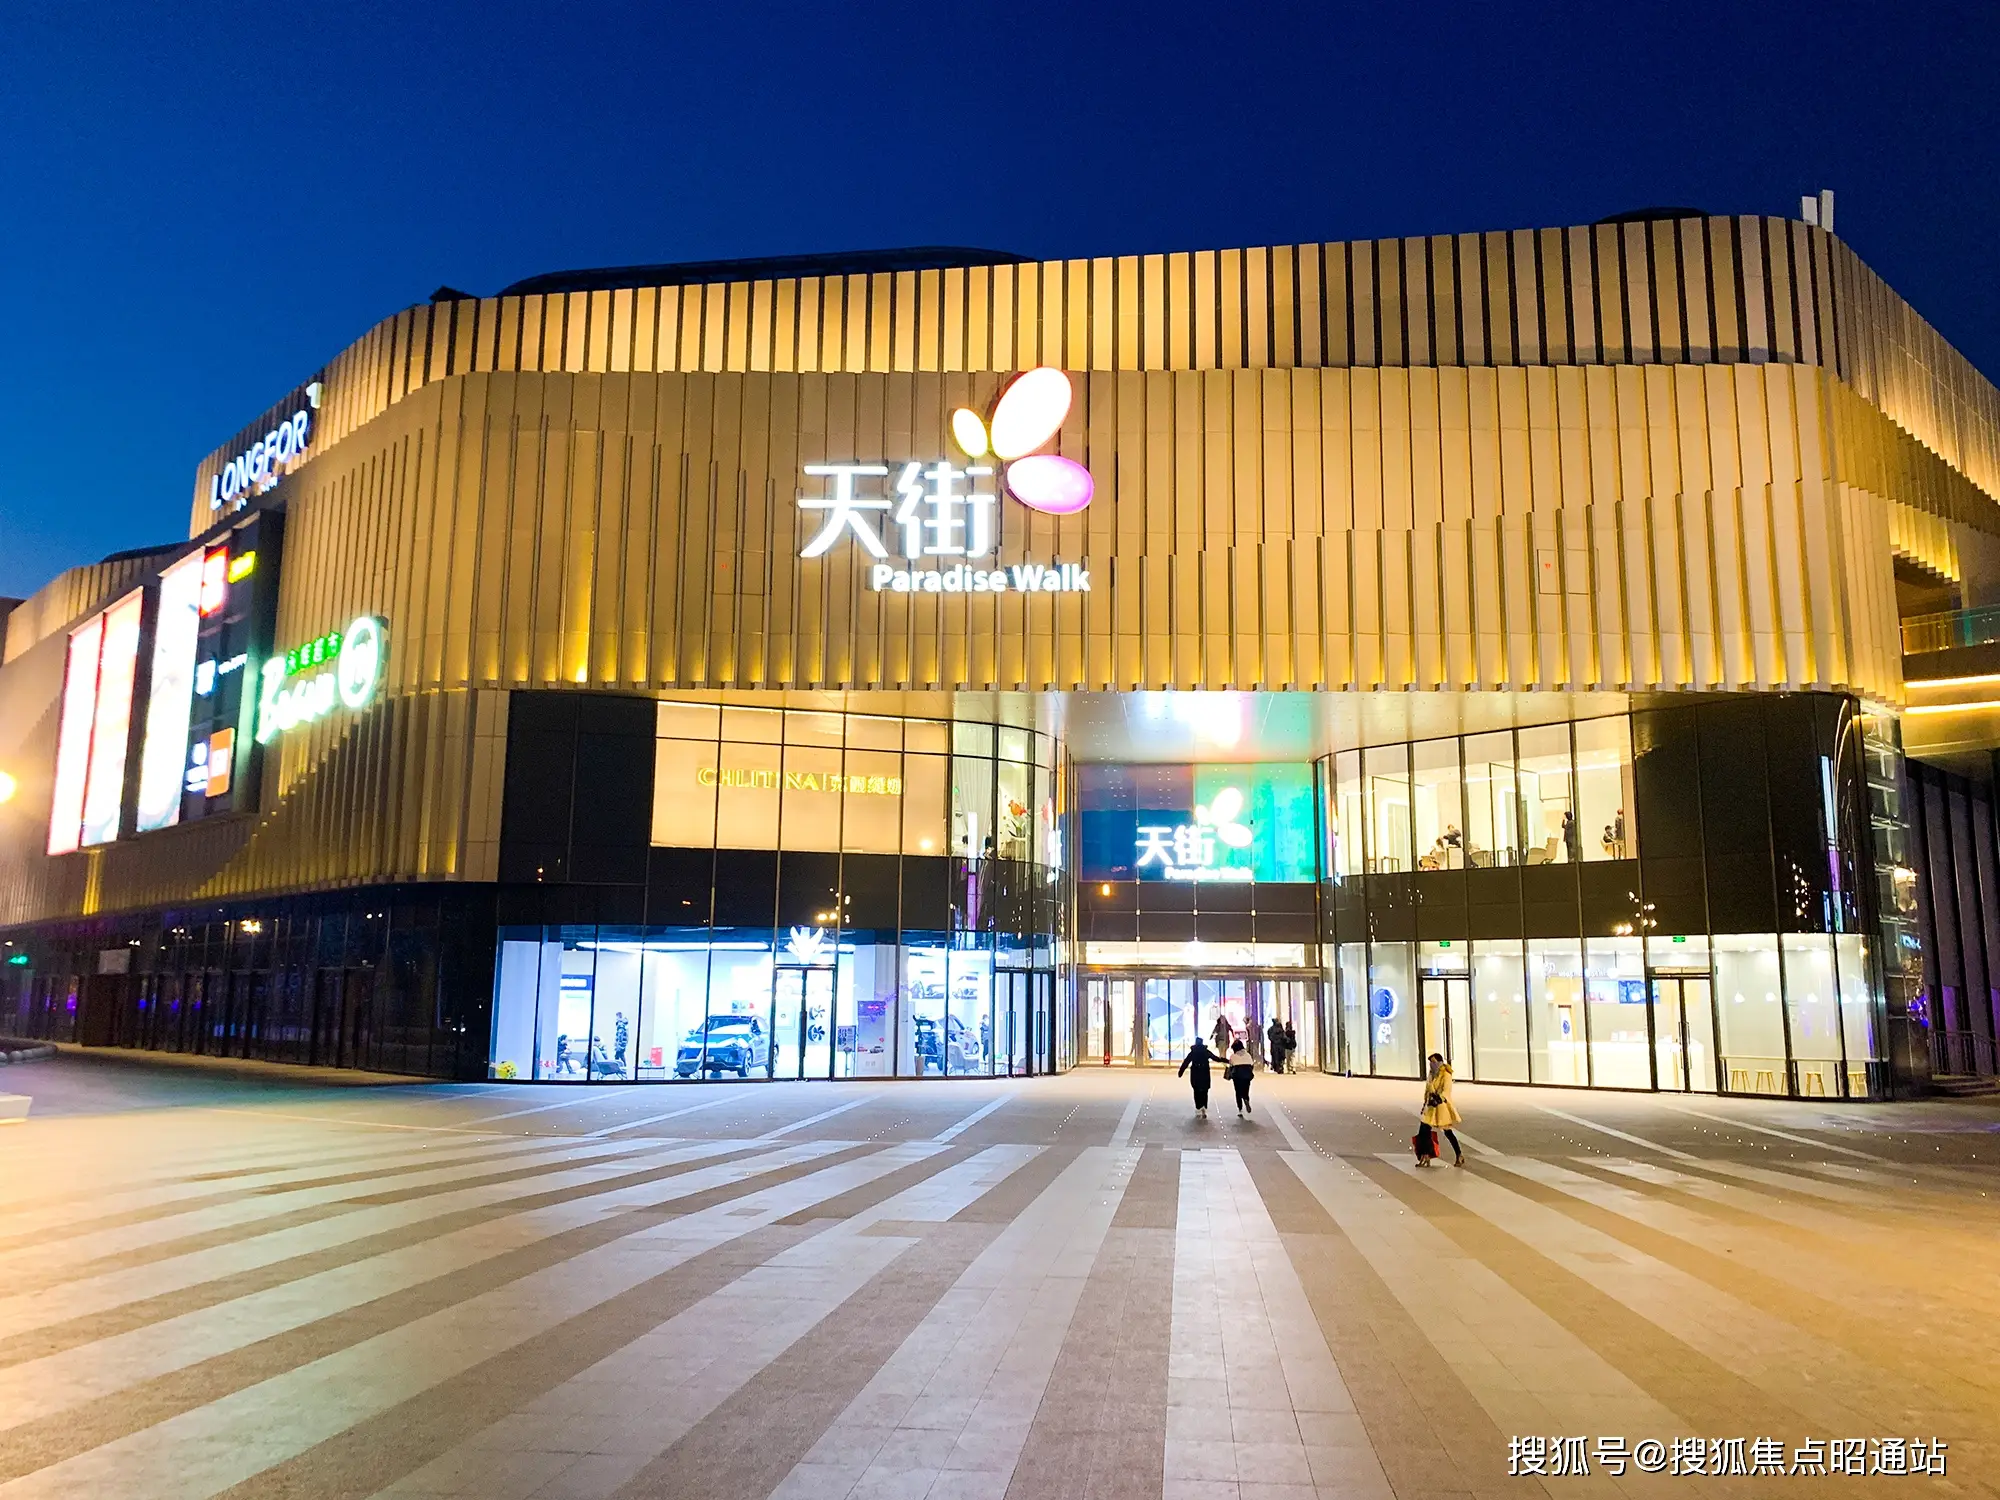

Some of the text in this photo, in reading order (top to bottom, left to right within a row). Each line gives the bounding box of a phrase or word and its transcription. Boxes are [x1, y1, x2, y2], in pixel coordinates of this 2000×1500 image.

[210, 410, 308, 511] LONGFOR
[797, 461, 996, 559] 天街
[872, 563, 1091, 592] Paradise Walk
[1135, 825, 1216, 866] 天街
